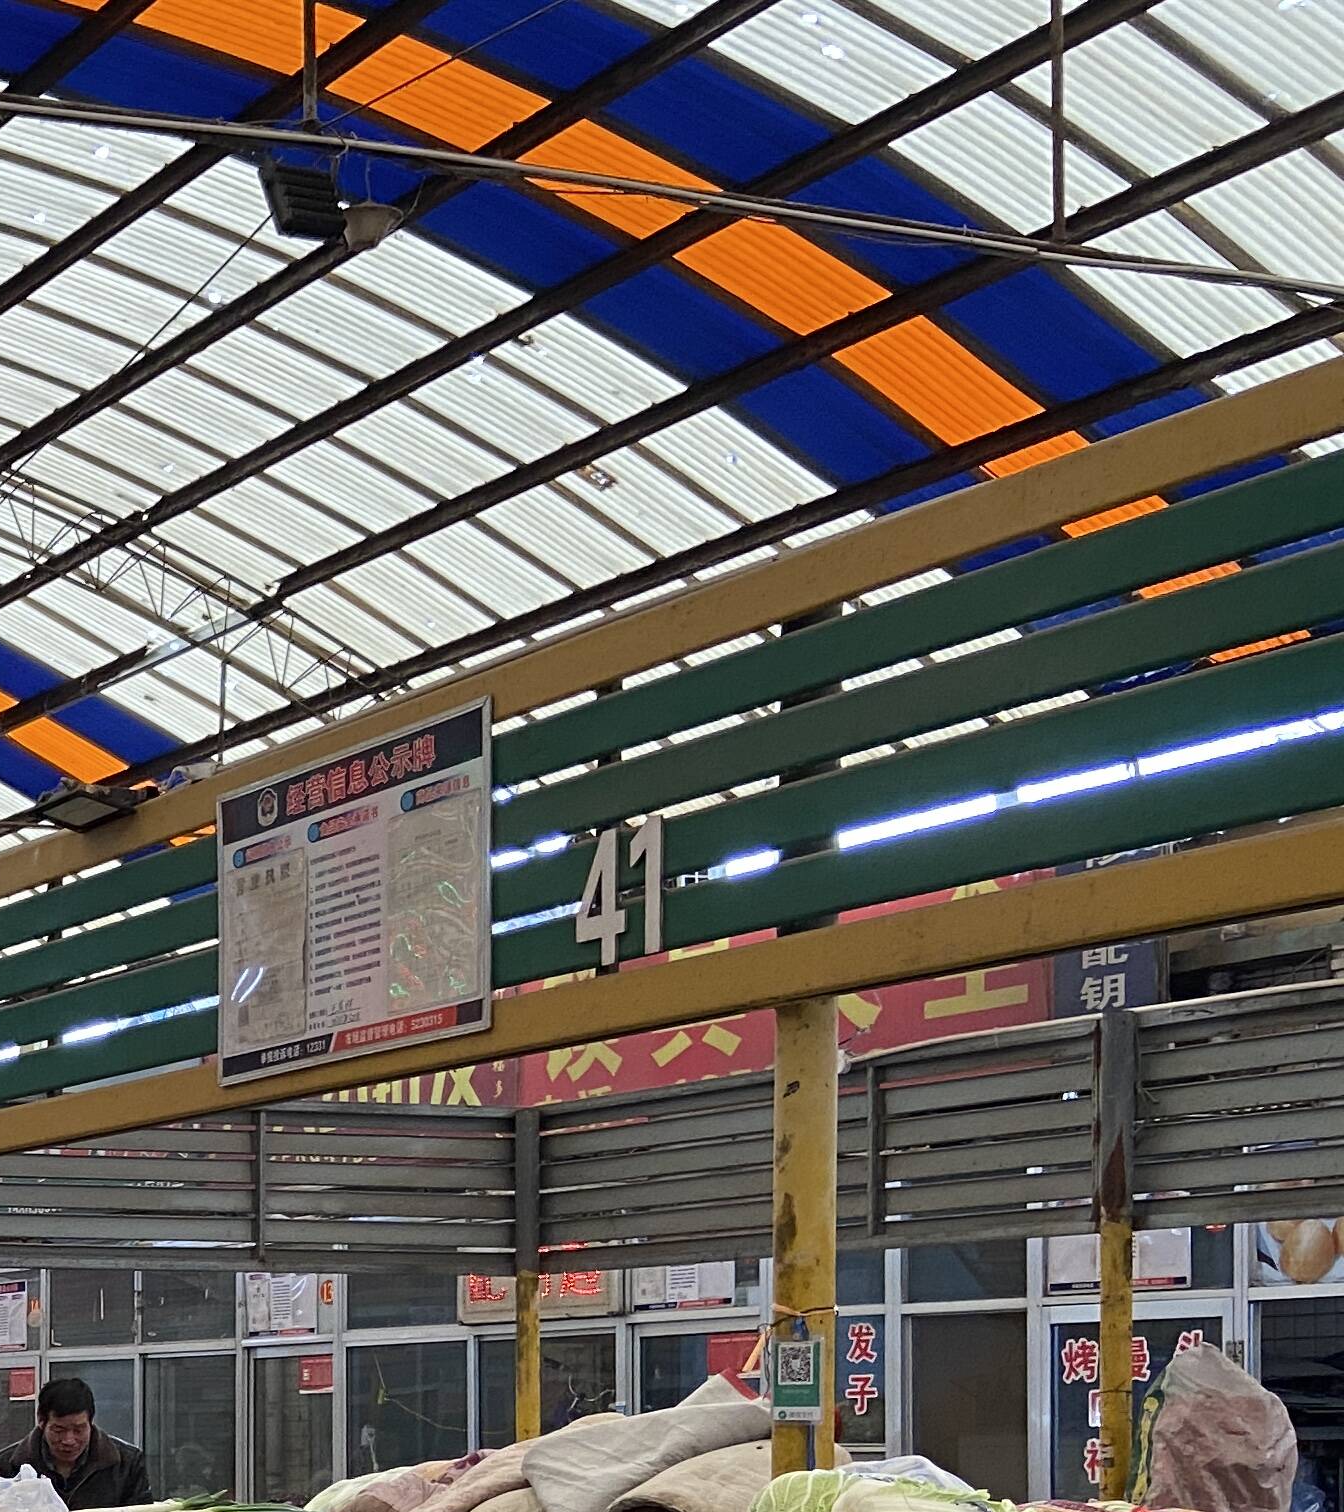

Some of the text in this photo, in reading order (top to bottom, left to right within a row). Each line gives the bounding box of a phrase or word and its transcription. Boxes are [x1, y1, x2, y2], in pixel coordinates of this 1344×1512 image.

[285, 733, 437, 817] 经营信息公示牌
[575, 816, 664, 966] 41
